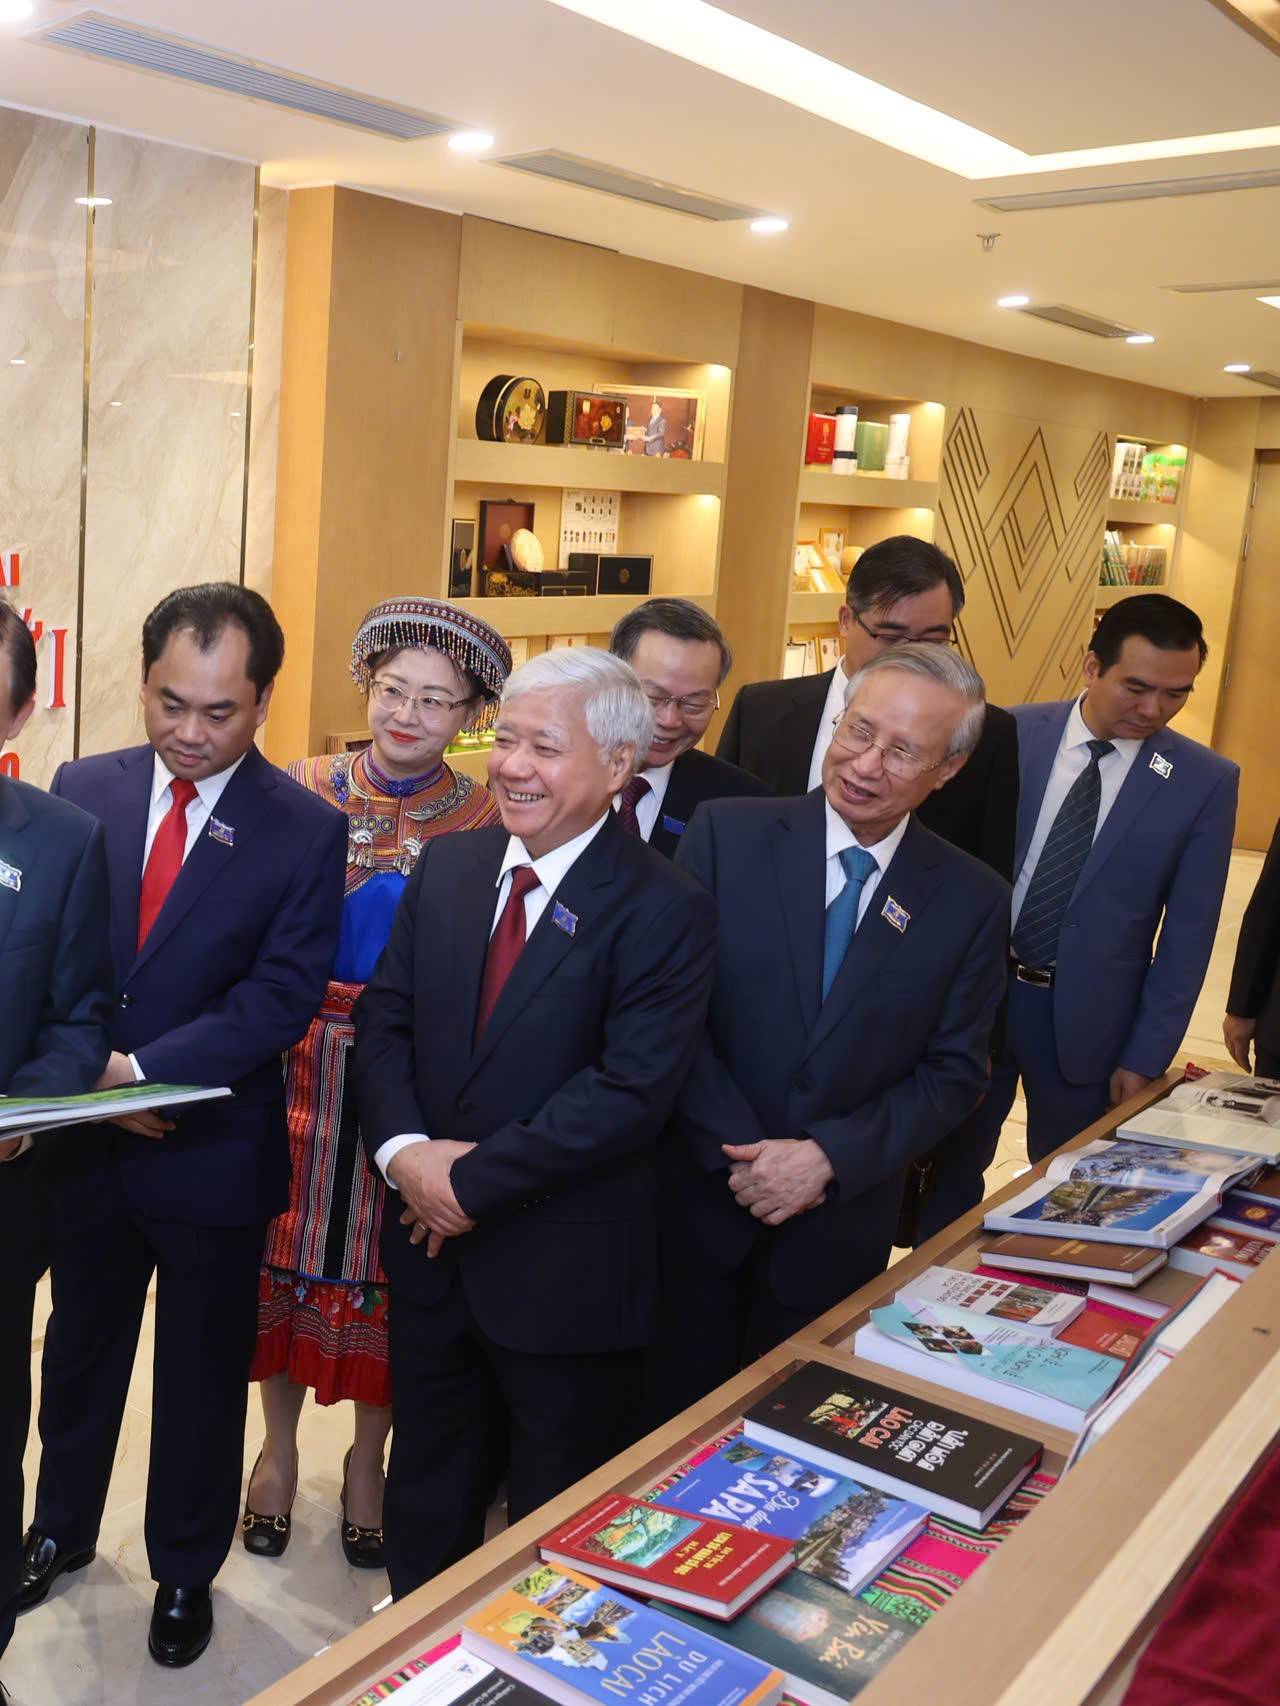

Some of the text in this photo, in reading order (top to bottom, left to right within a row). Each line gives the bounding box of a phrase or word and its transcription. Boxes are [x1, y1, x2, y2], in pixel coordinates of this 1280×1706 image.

[858, 1427, 891, 1449] CAI
[632, 1631, 686, 1671] LÀO
[677, 1650, 708, 1674] DU
[600, 1664, 647, 1697] CAI
[637, 1673, 683, 1706] LỊCH
